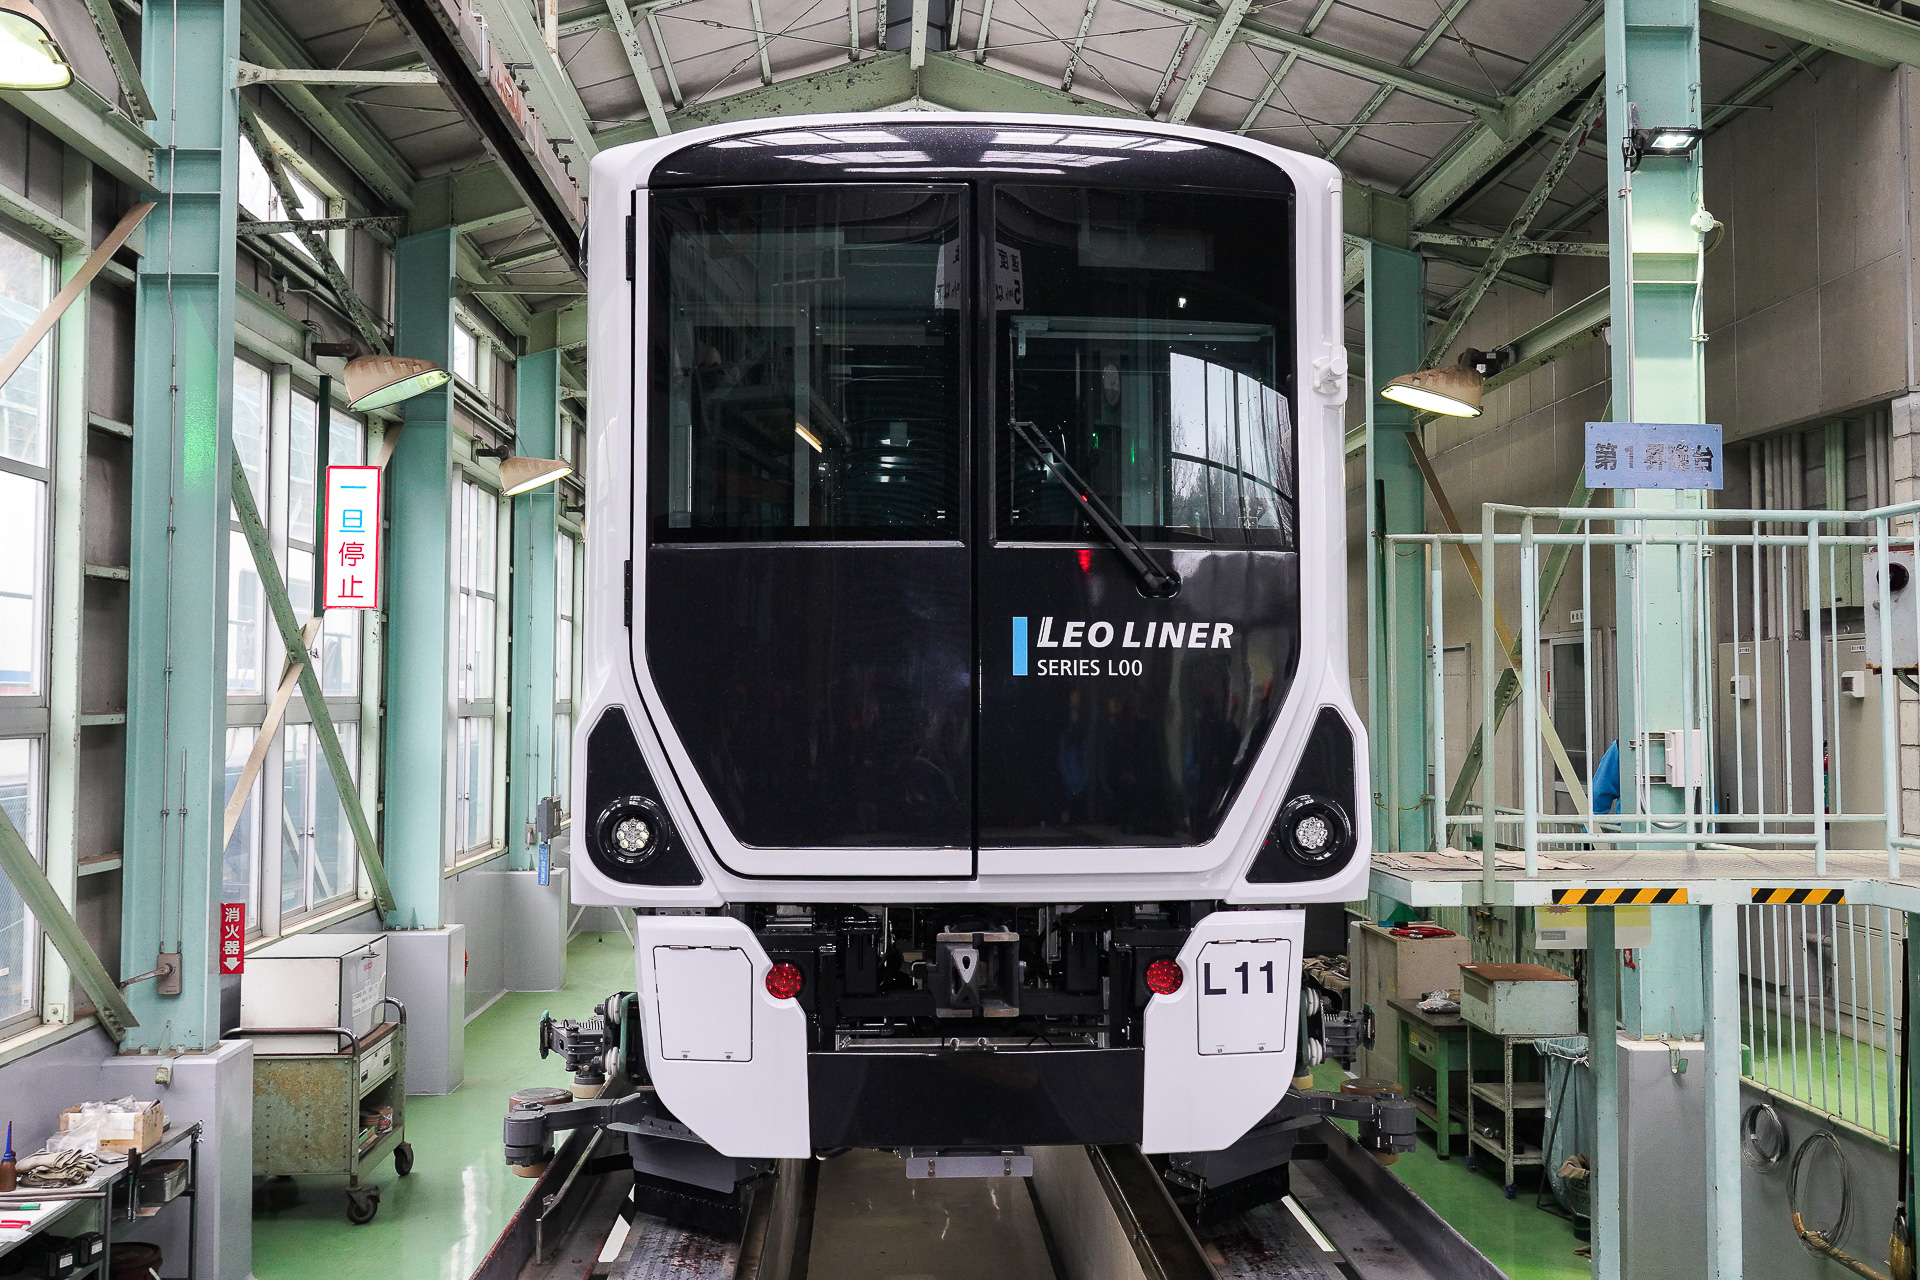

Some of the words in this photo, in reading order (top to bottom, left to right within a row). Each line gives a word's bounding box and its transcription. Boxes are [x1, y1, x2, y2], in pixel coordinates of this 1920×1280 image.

[337, 485, 366, 599] 一旦停止
[1037, 617, 1114, 648] LEO
[1121, 621, 1234, 649] LINER
[1037, 659, 1101, 676] SERIES
[1107, 659, 1143, 676] L00
[224, 906, 241, 956] 消火器
[1203, 960, 1274, 995] L11
